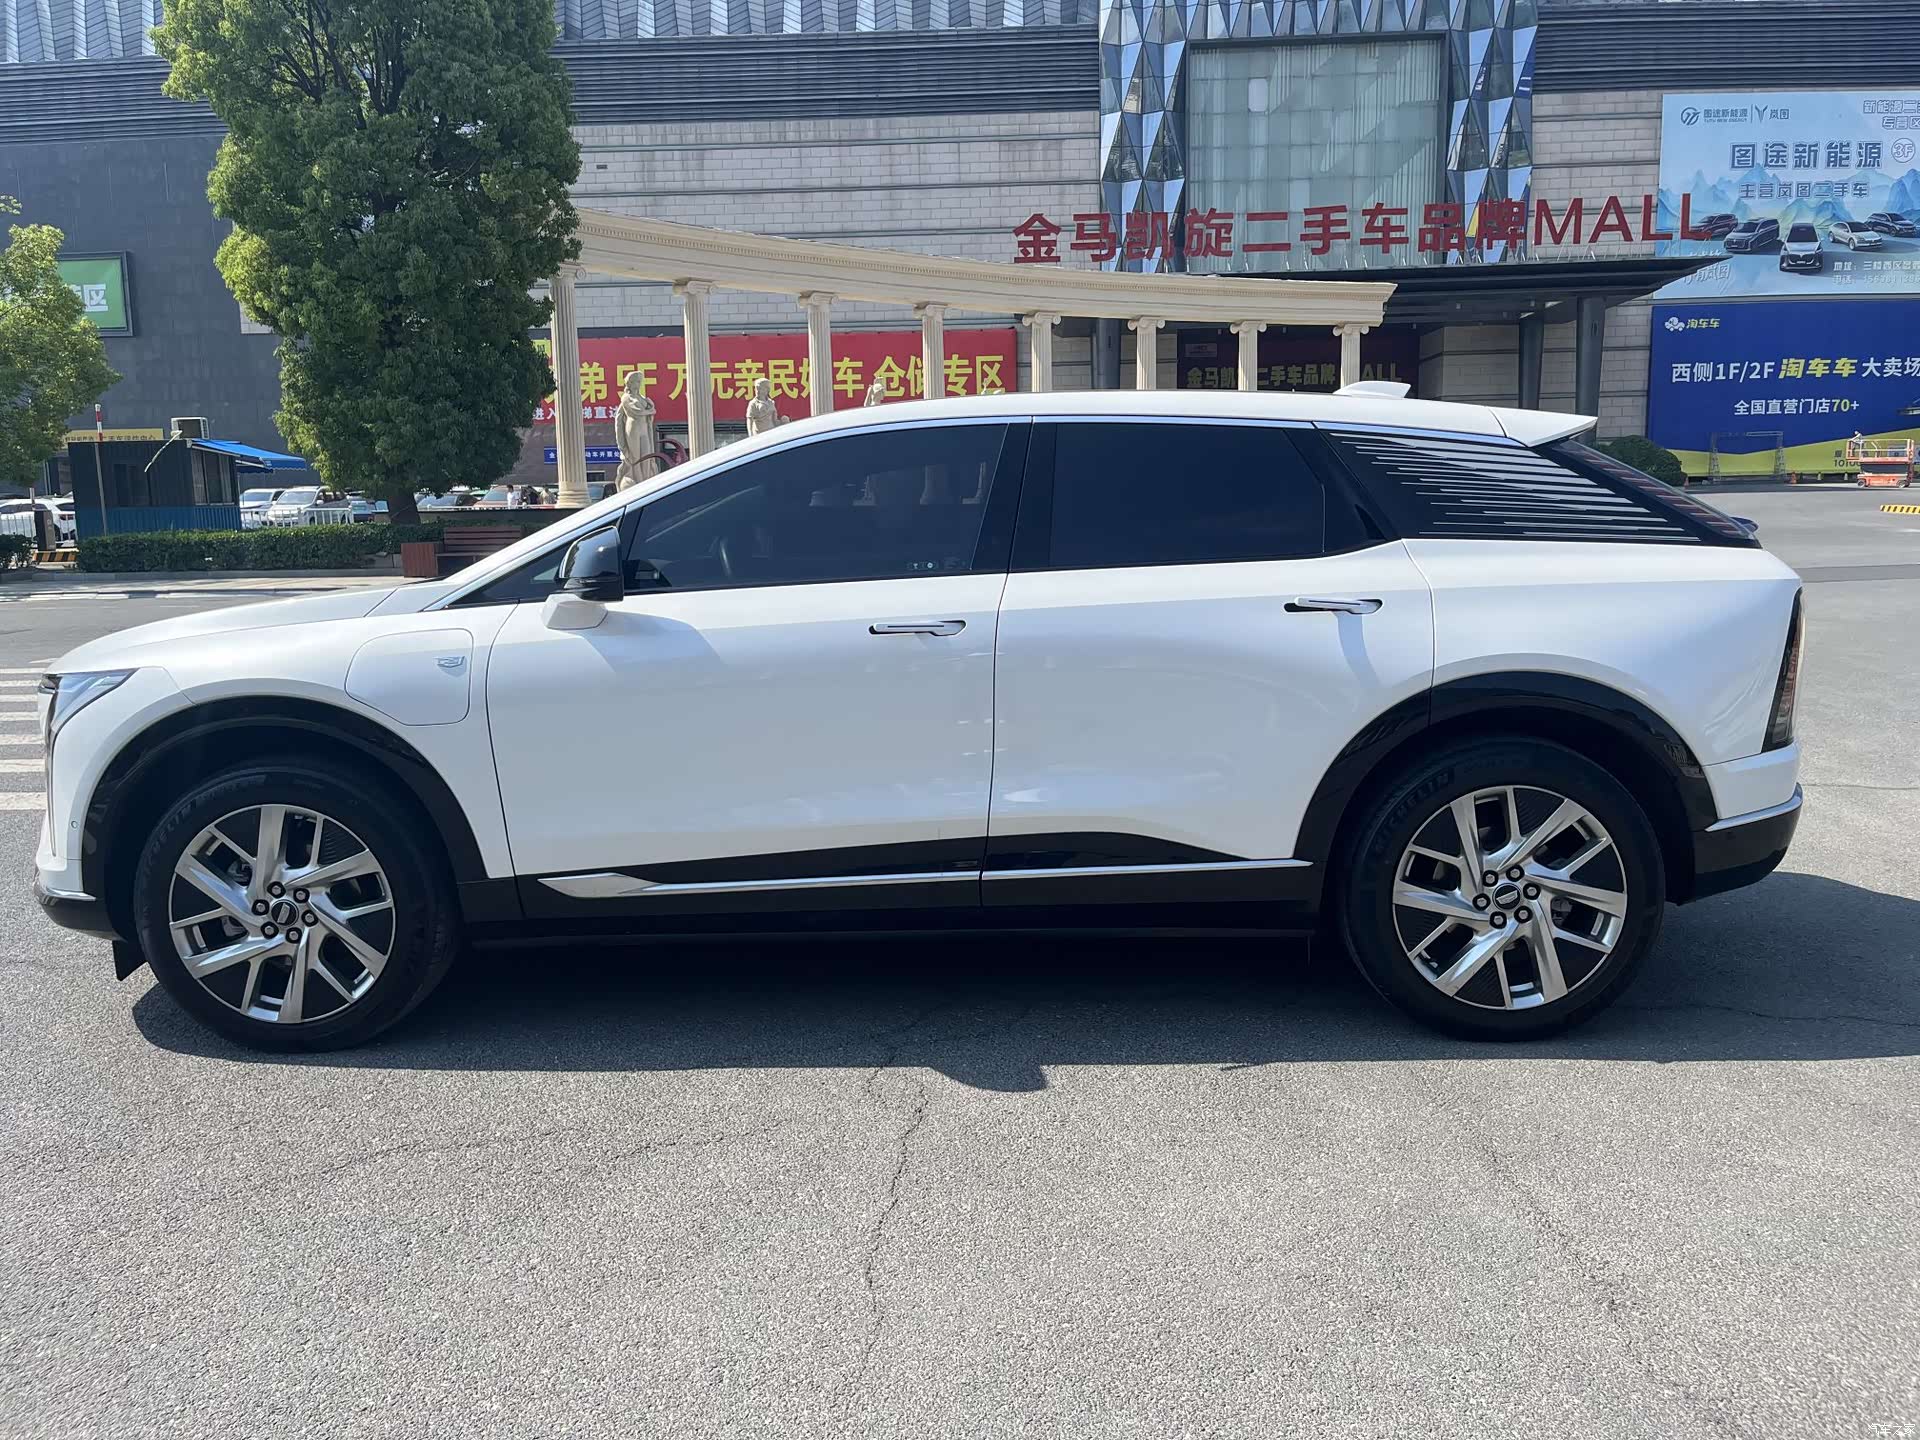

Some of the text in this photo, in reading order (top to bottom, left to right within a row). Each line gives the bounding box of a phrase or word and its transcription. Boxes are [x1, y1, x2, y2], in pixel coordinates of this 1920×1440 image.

[1769, 108, 1790, 120] 岚图
[1863, 100, 1920, 114] 新能源二
[1730, 141, 1883, 170] 图途新能源
[1893, 143, 1914, 159] 3F
[1740, 182, 1868, 198] 主营岚图二手车
[1686, 318, 1720, 329] 淘车车
[1778, 358, 1858, 379] 淘车车
[1733, 398, 1860, 415] 全国直营门店70+
